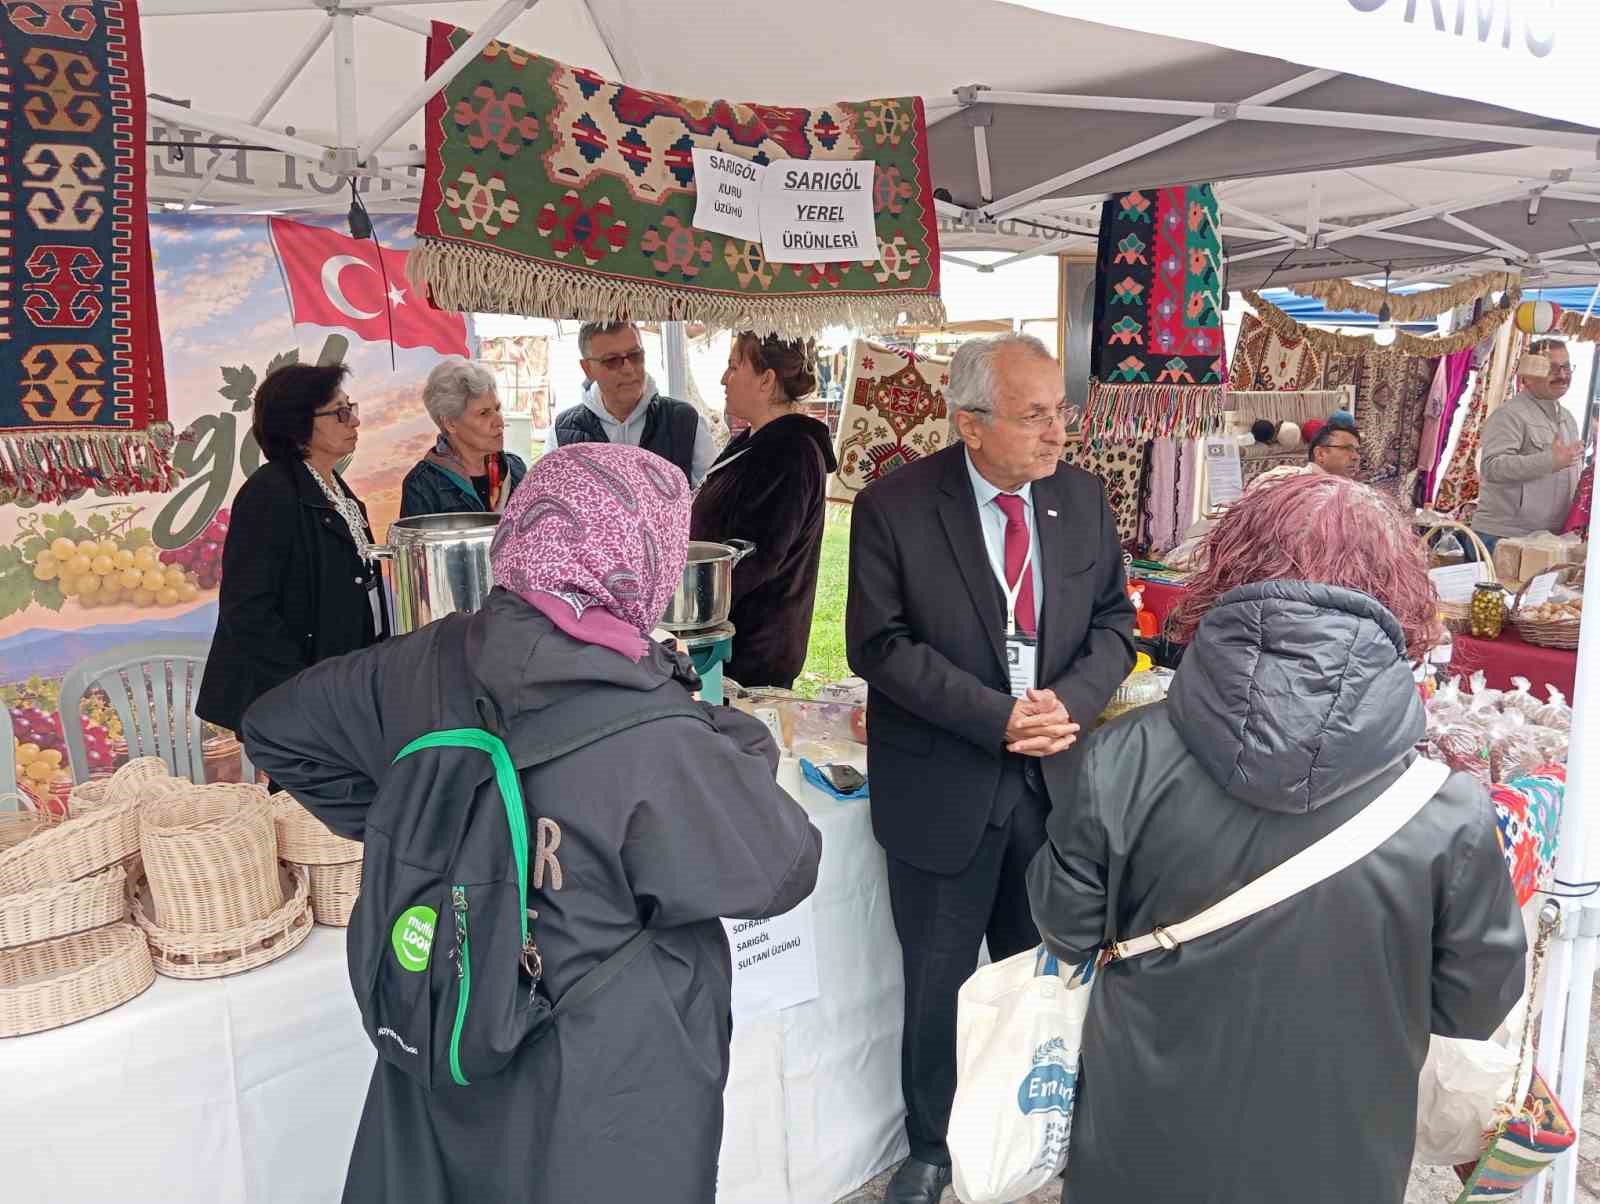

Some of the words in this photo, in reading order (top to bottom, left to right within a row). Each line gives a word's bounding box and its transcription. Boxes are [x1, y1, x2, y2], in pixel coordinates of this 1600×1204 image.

[710, 155, 757, 182] SARIGÖL
[784, 168, 862, 190] SARIGÖL
[718, 183, 742, 199] KURU
[796, 204, 845, 221] YEREL
[782, 230, 858, 249] ÜRÜNLERİ
[736, 931, 770, 953] SARIGÖL
[738, 947, 771, 971] SULTANİ
